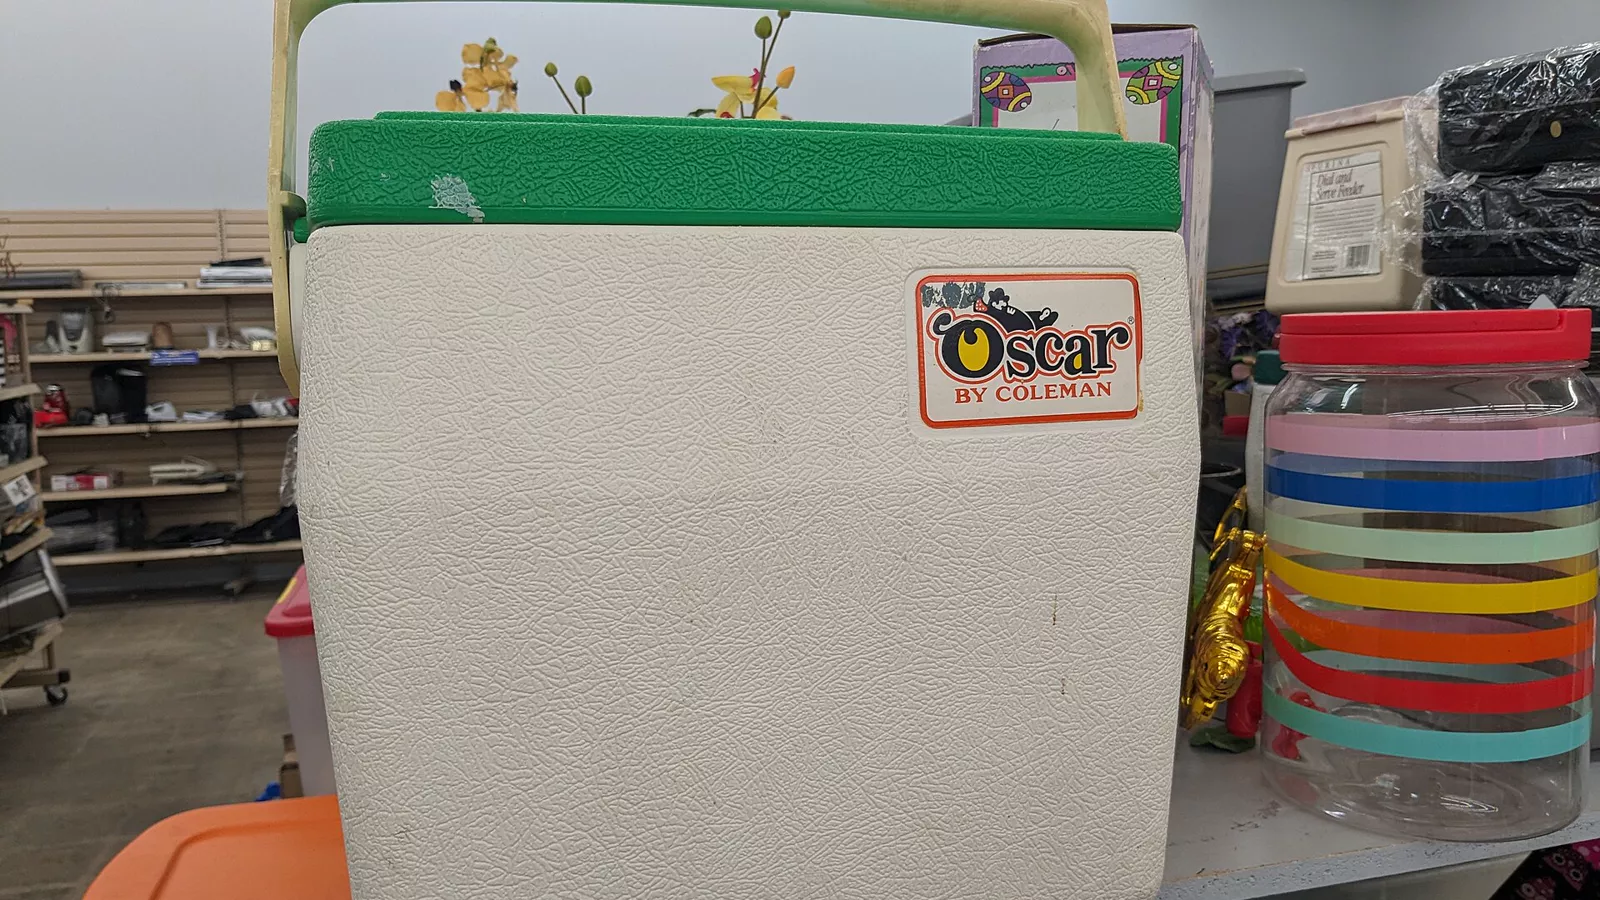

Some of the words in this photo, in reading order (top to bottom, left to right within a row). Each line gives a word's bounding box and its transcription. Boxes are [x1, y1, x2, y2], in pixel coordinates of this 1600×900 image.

[1335, 168, 1354, 184] and
[1316, 187, 1337, 201] Serve
[1337, 181, 1365, 198] Feeder
[932, 312, 1130, 379] Oscar
[955, 387, 988, 404] BY
[995, 381, 1112, 402] COLEMAN
